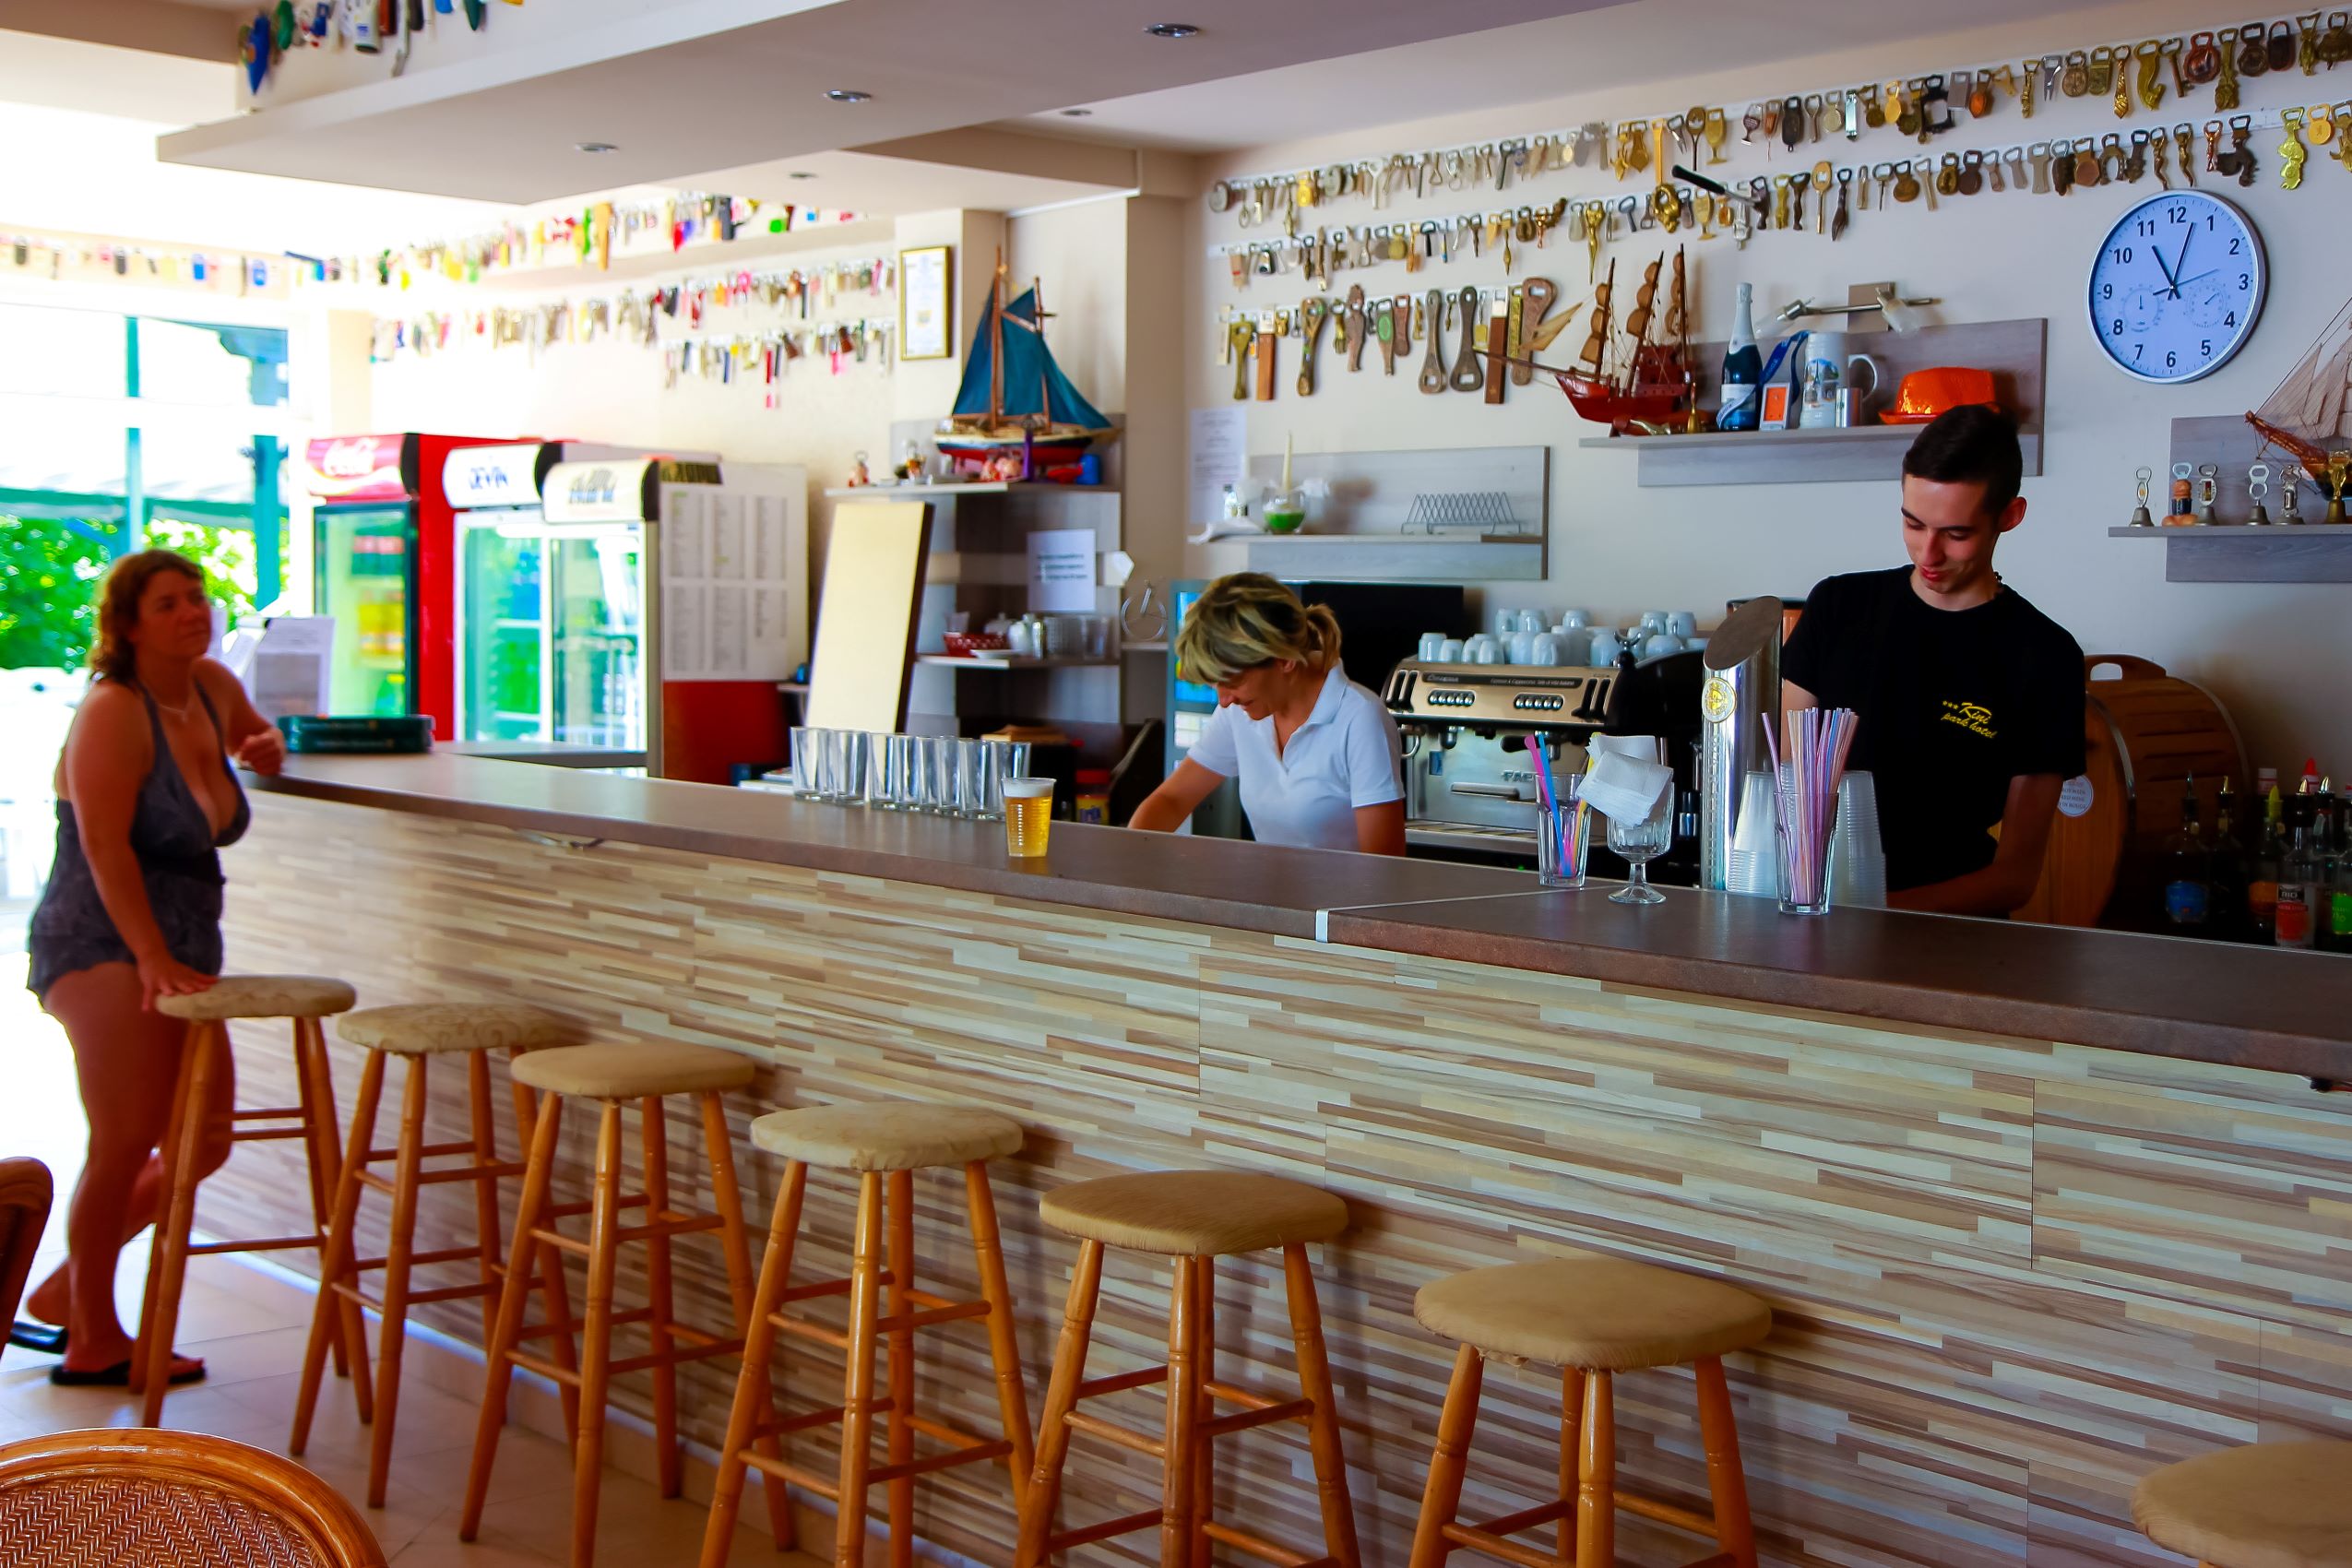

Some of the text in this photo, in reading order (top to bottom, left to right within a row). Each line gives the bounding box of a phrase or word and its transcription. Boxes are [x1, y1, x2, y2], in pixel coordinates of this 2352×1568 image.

[2167, 206, 2187, 224] 12
[2206, 215, 2215, 232] 1
[2136, 220, 2156, 237] 11
[2113, 246, 2132, 265] 10
[2228, 238, 2239, 255] 2
[2238, 273, 2249, 291] 3
[2102, 284, 2113, 300] 9
[2112, 318, 2124, 336] 8
[2223, 311, 2235, 327] 4
[2134, 343, 2144, 361] 7
[2200, 339, 2212, 356] 5
[2166, 350, 2177, 368] 6
[1940, 713, 1999, 739] park hotel
